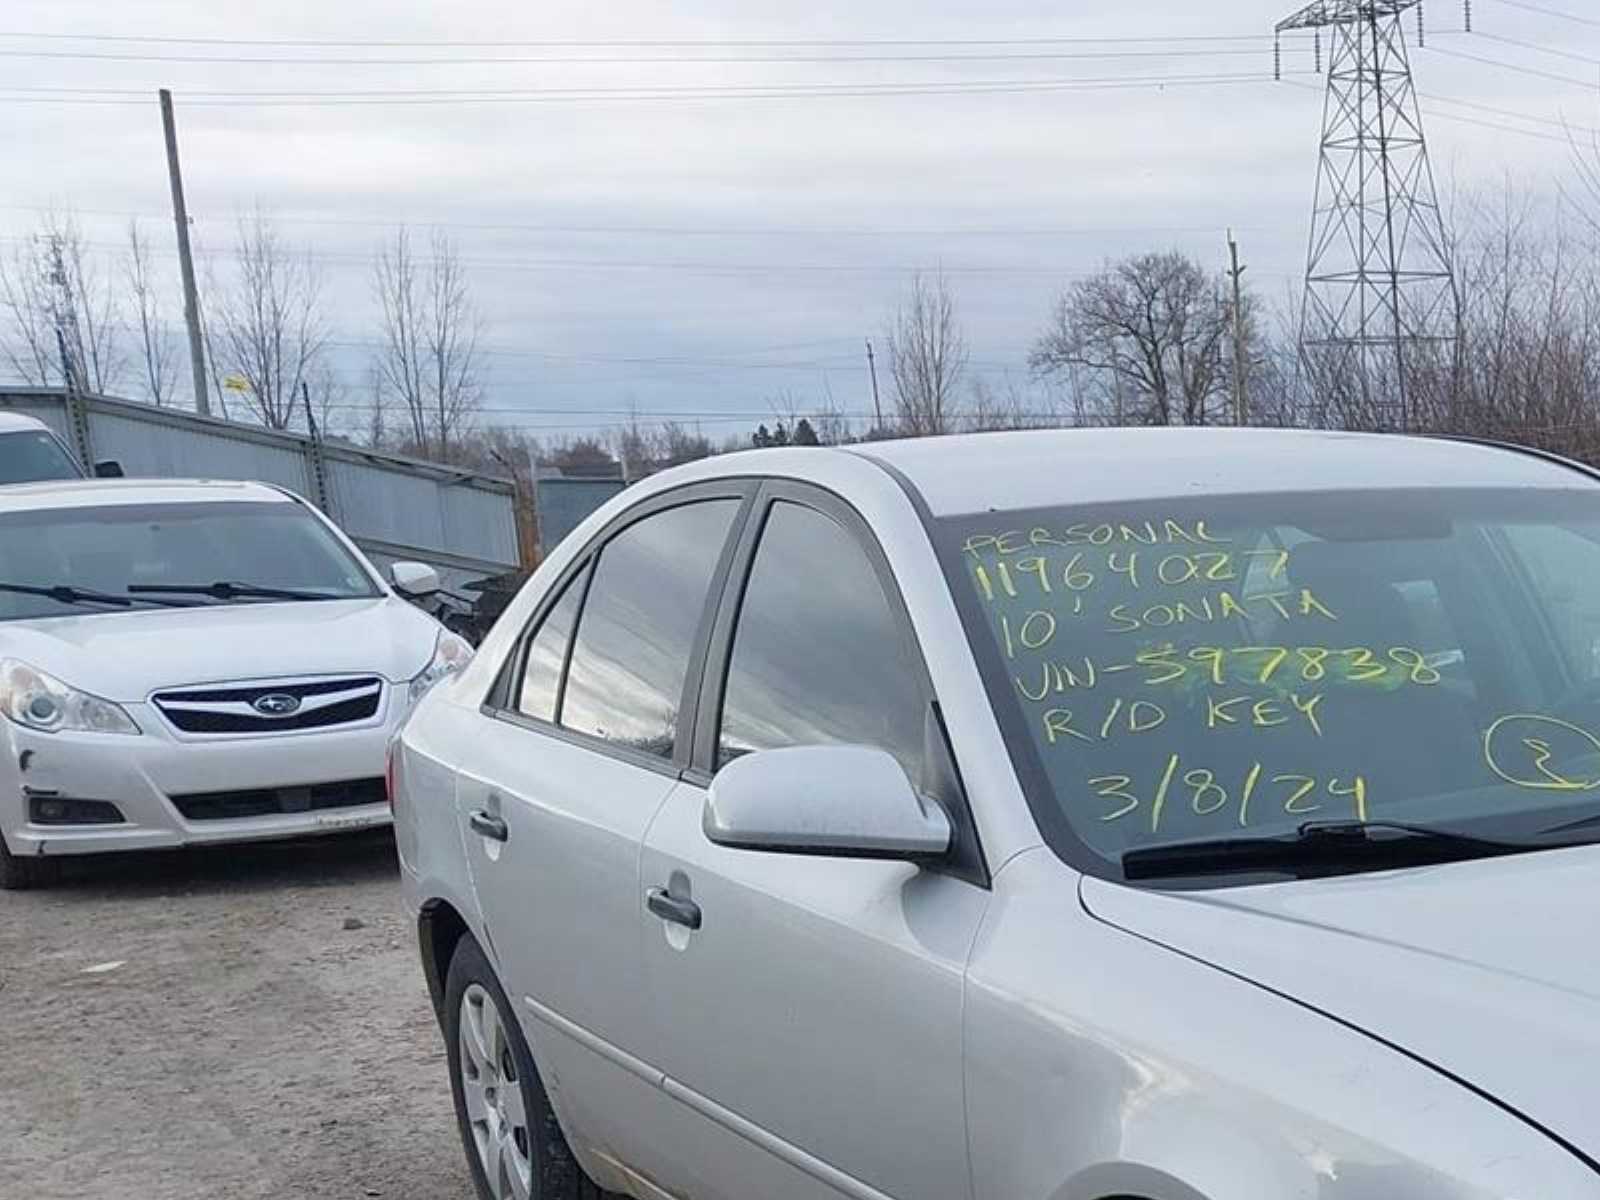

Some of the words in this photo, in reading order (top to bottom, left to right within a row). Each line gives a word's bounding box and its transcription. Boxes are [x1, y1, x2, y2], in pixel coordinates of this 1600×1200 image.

[963, 520, 1232, 557] PERSONAL
[976, 551, 1289, 600] 11964027
[1105, 590, 1337, 632] SONATA
[1043, 698, 1166, 743] R/D
[1208, 694, 1326, 737] KEY
[1087, 754, 1367, 832] 3/8/24
